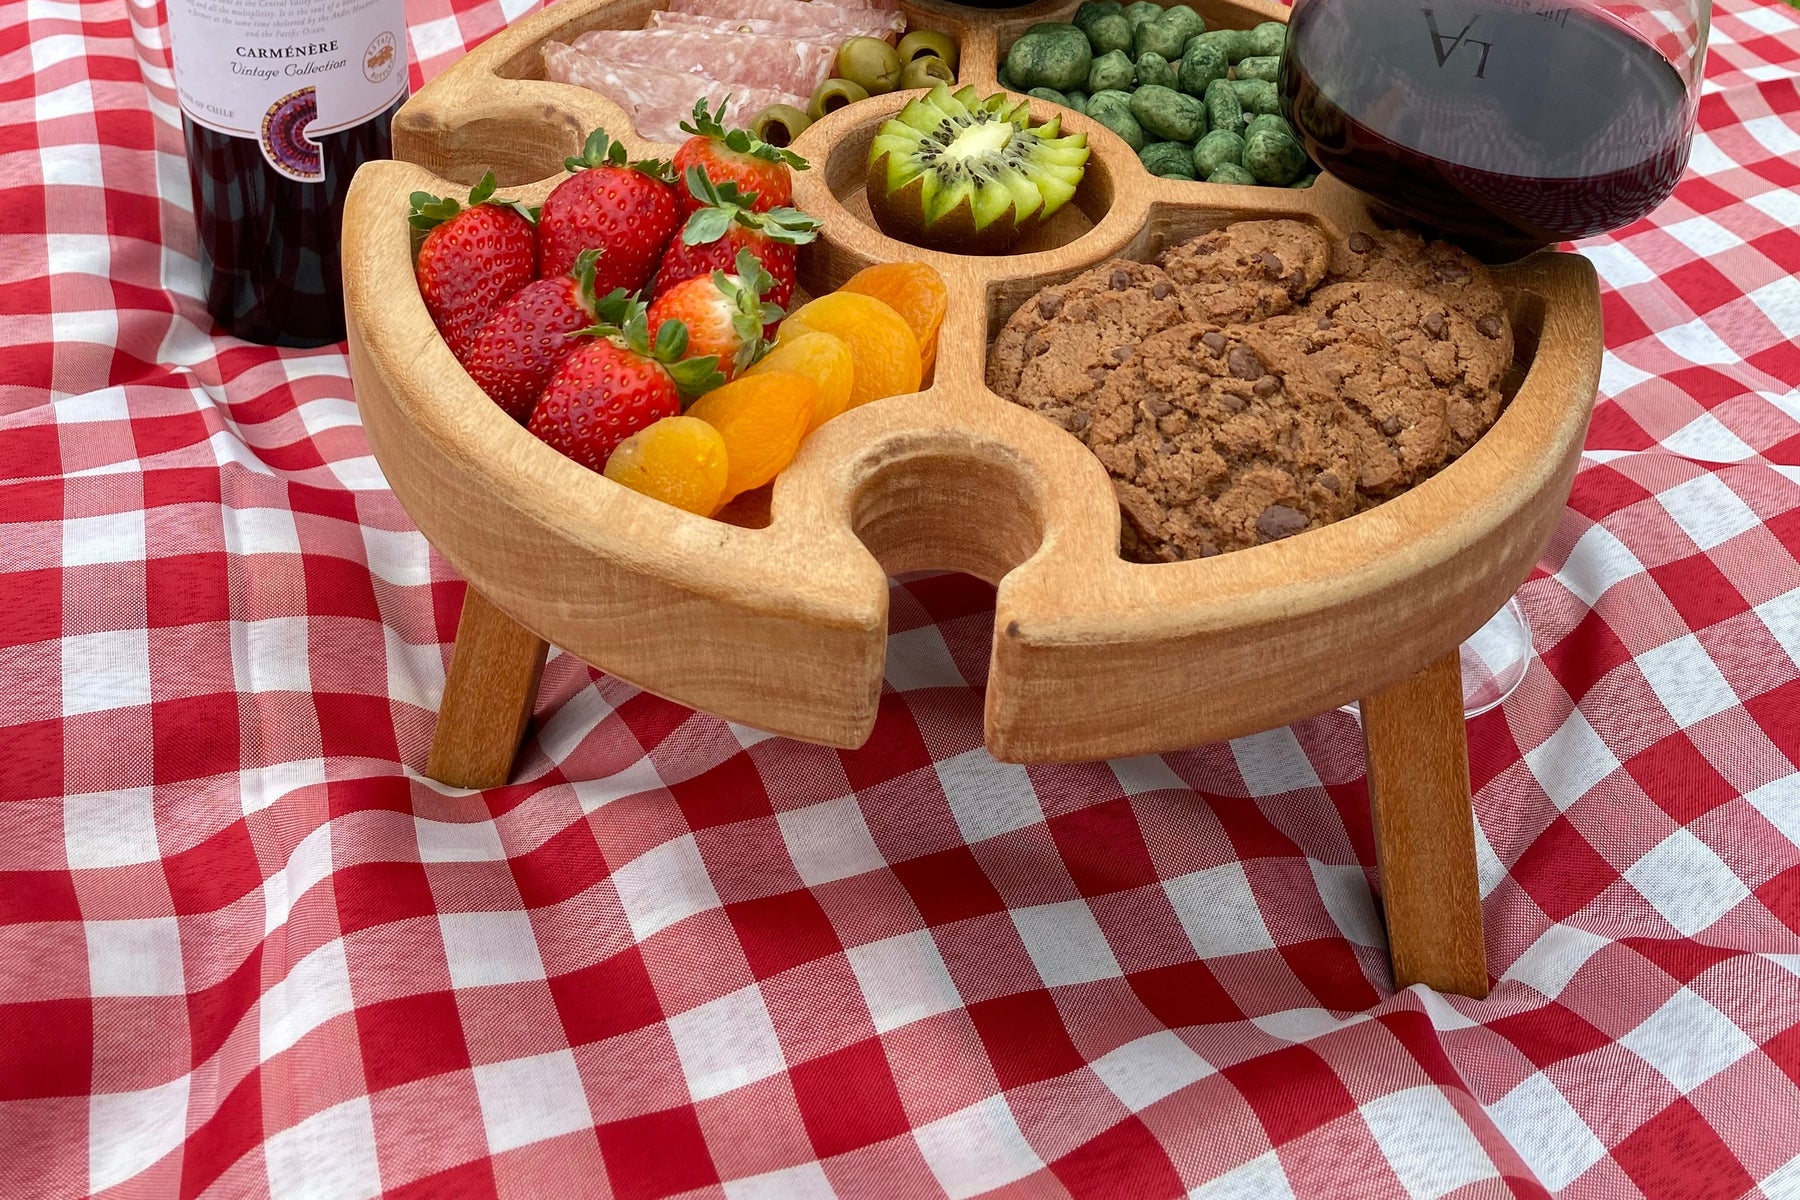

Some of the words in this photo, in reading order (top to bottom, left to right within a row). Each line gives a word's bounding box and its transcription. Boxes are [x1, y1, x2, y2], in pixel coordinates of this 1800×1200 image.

[308, 16, 316, 26] by
[261, 30, 273, 38] the
[1419, 8, 1493, 79] LA
[236, 40, 339, 59] CARMÉNÈRE
[368, 35, 392, 56] ESTATE
[230, 61, 280, 81] Vintage
[284, 58, 347, 77] Collection
[206, 104, 235, 118] CHILE
